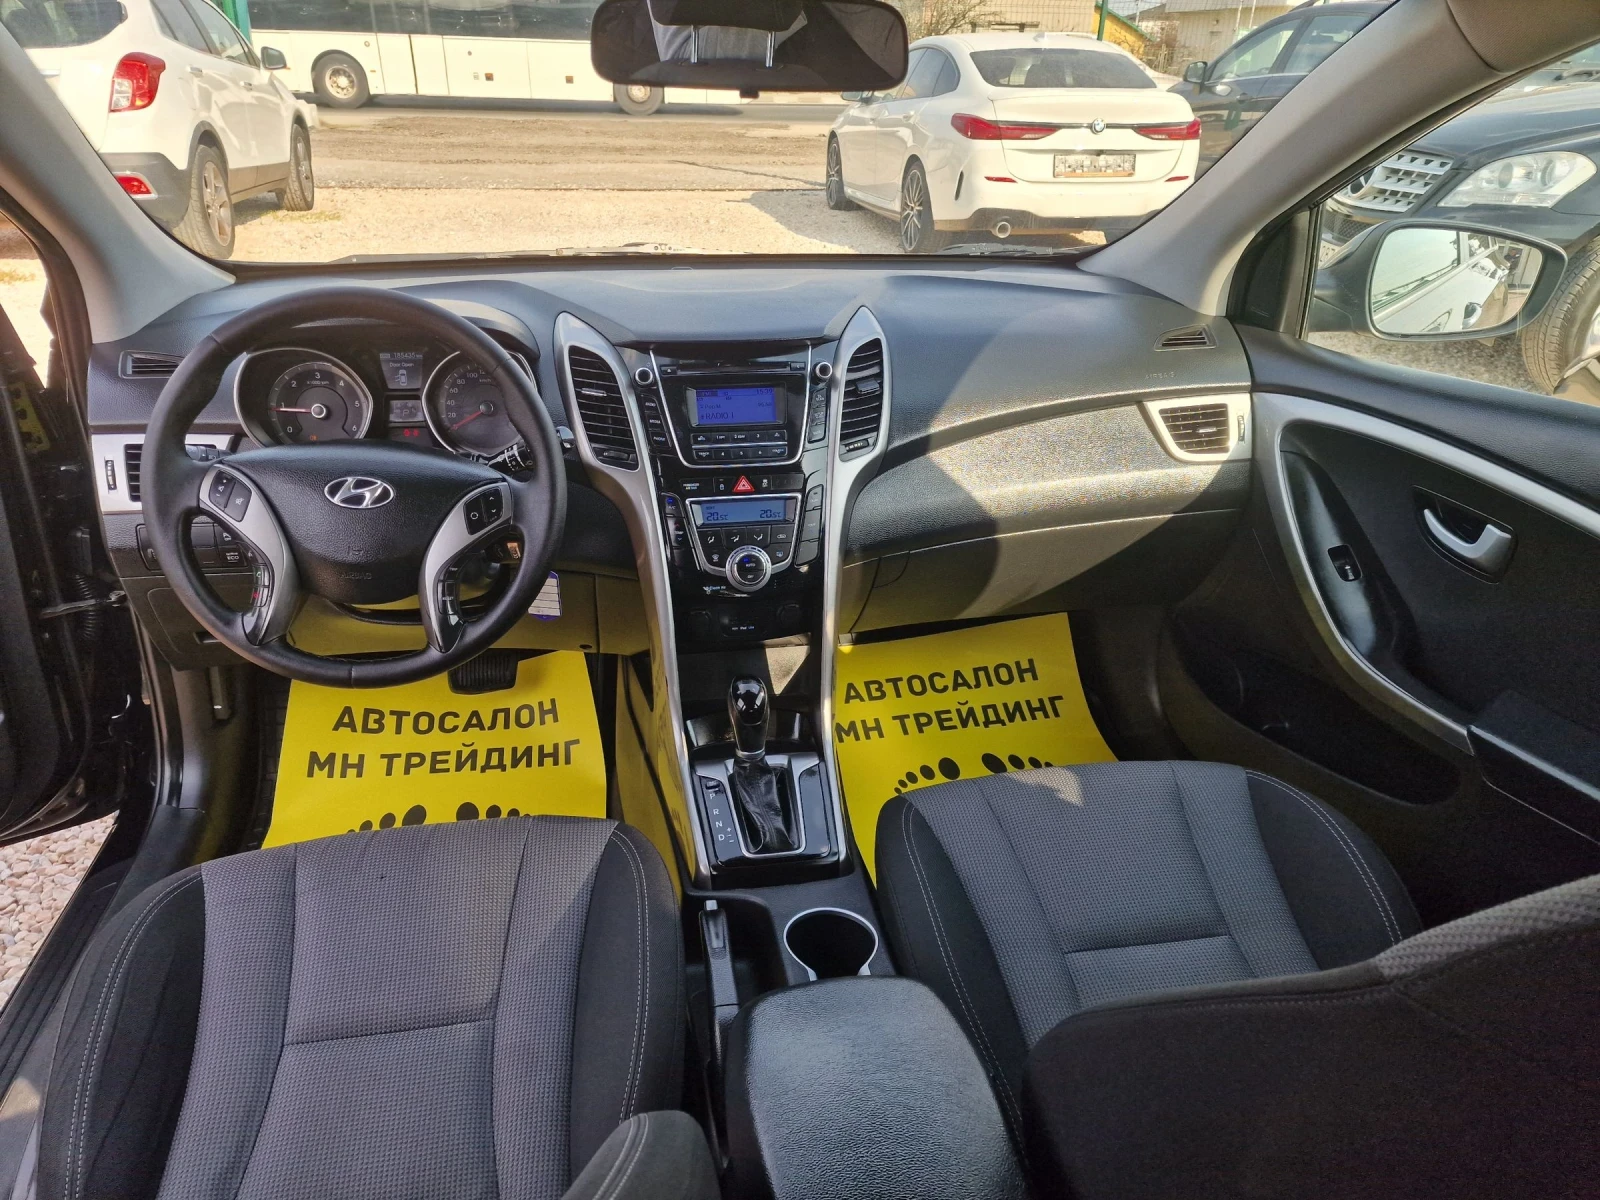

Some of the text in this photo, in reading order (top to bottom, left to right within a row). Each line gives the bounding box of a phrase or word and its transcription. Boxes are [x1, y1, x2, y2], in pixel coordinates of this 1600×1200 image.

[844, 658, 1038, 704] АВТОСАЛОН
[332, 698, 560, 735] АВТОСАЛОН
[835, 696, 1064, 744] МН ТРЕЙДИНГ
[306, 740, 580, 778] МН ТРЕЙДИНГ
